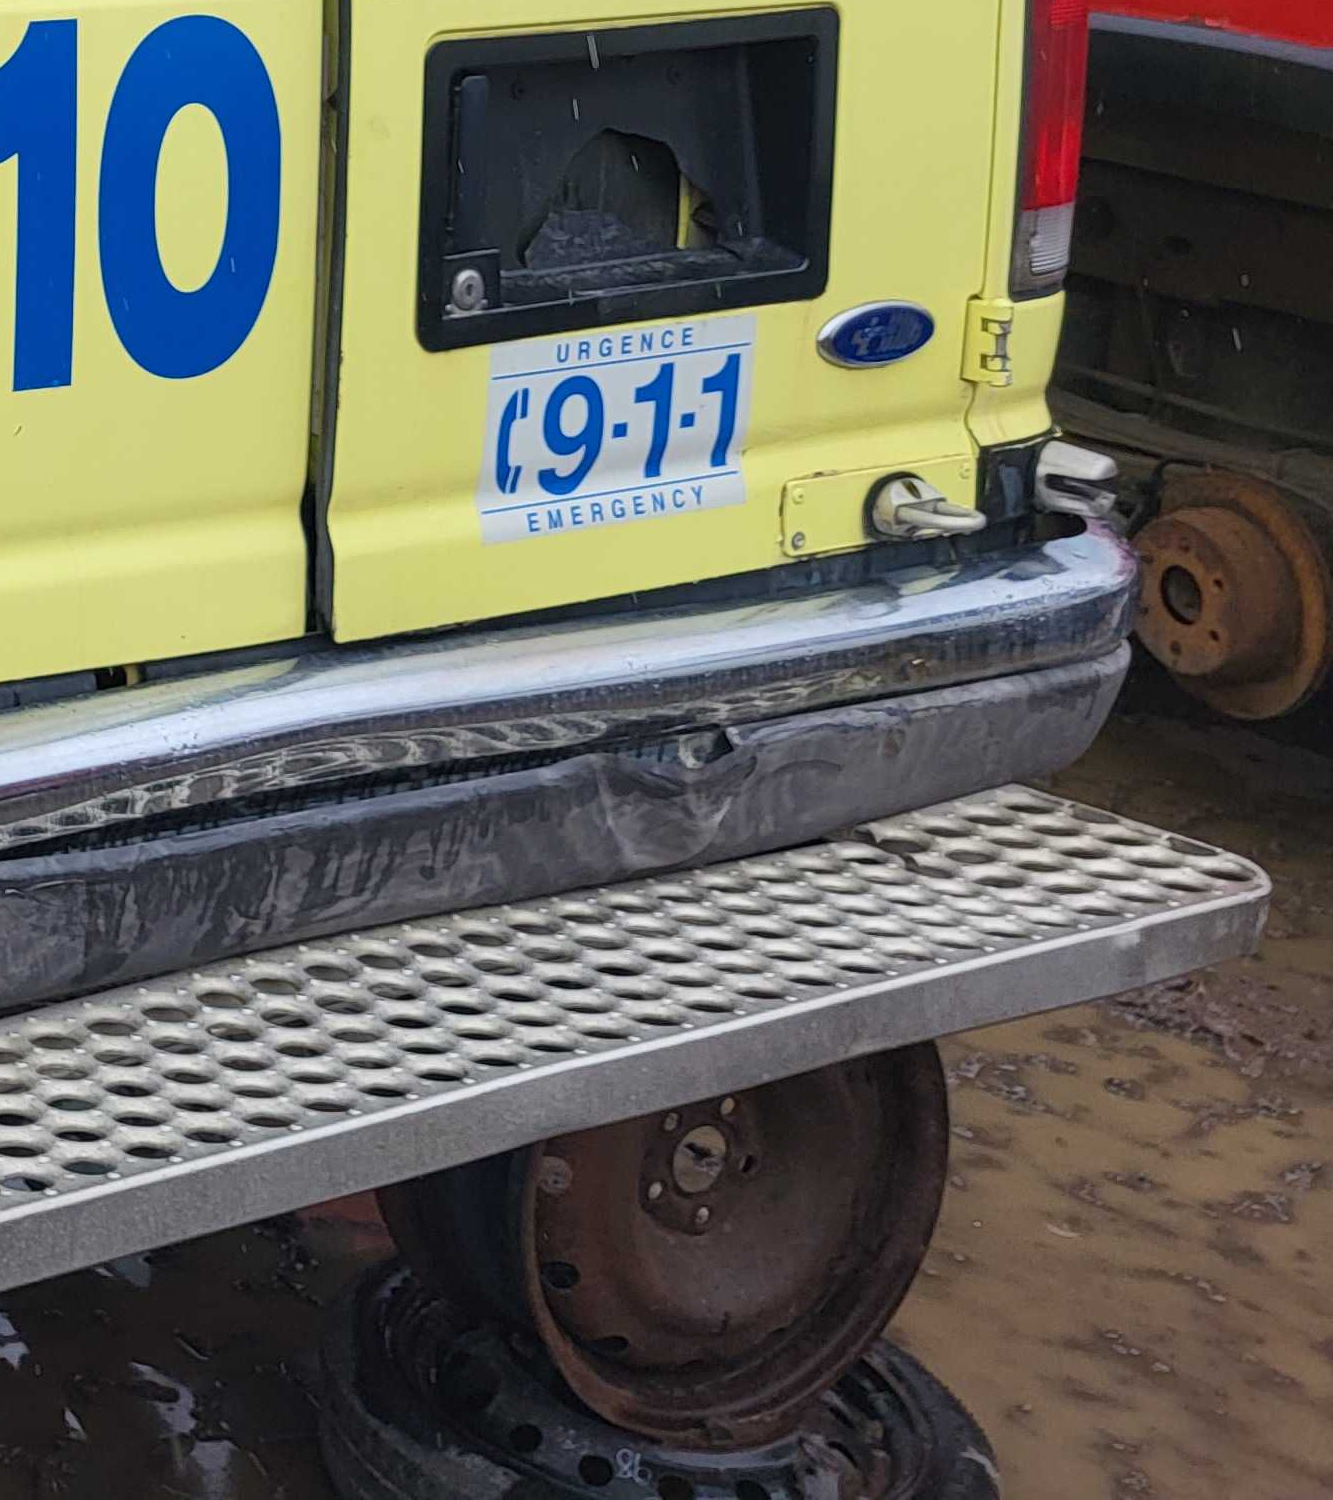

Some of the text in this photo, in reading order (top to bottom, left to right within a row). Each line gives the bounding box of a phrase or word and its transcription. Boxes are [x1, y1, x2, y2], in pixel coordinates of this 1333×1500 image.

[556, 327, 695, 364] URGENCE
[538, 353, 741, 495] 9-1-1
[526, 485, 705, 533] EMERGENCY
